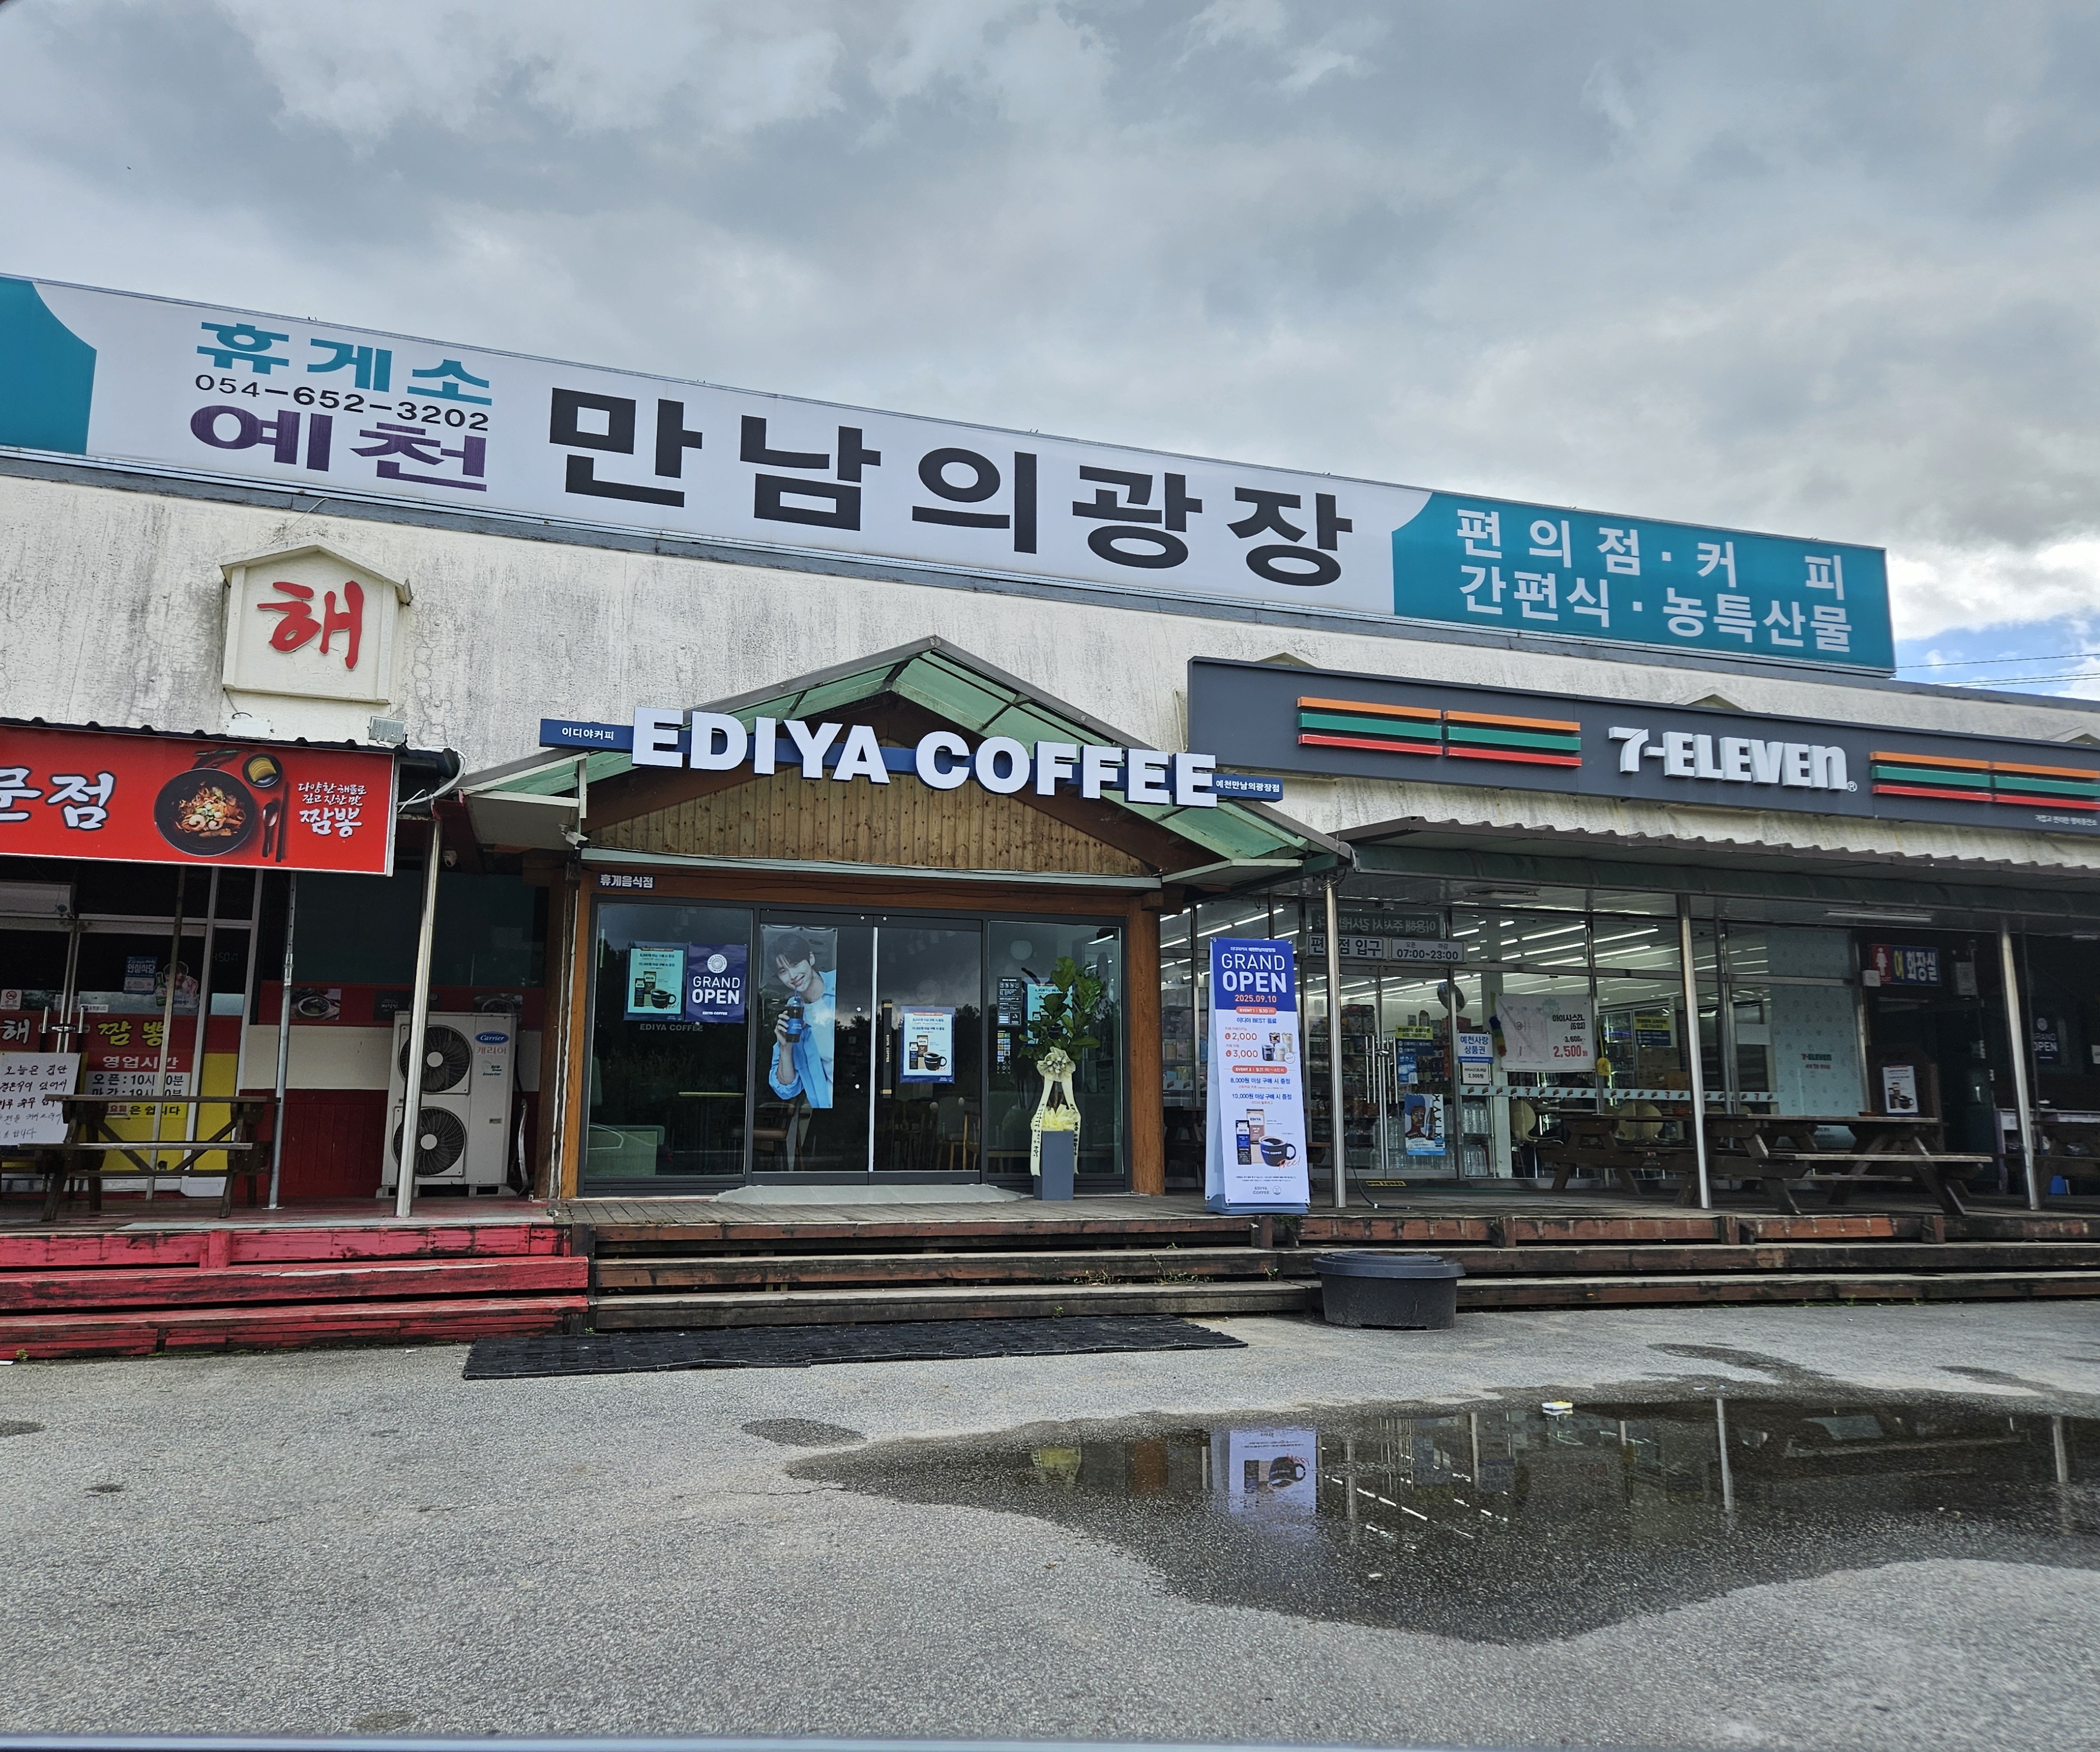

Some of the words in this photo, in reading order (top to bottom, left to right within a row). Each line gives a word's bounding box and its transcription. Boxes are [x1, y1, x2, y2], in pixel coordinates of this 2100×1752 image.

[196, 322, 493, 407] 휴게소
[194, 374, 490, 431] 054-652-3202
[190, 405, 487, 492] 예천
[256, 580, 365, 672] 해
[562, 727, 614, 741] 이디야커피
[632, 706, 890, 785] EDIYA
[915, 731, 1217, 807] COFFEE
[298, 781, 337, 794] 다양한
[337, 784, 367, 795] 해물로
[1216, 780, 1280, 793] 예천만남의광장점
[302, 793, 322, 804] 깊고
[323, 794, 347, 806] 진한
[348, 795, 363, 806] 맛
[299, 807, 362, 837] 짬뽕
[600, 873, 653, 889] 휴게음식점
[1310, 936, 1351, 955] 편점
[1355, 938, 1381, 957] 입구
[1396, 948, 1459, 960] 07:00~23:00
[1221, 953, 1285, 971] GRAND
[1893, 950, 1904, 979] 여
[1906, 950, 1938, 982] 화장실
[692, 976, 741, 989] GRAND
[1223, 971, 1287, 993] OPEN
[692, 988, 740, 1005] OPEN
[1234, 994, 1277, 1003] 2025.09.10
[0, 1018, 31, 1044] 해
[669, 1024, 704, 1032] COFFEE
[1232, 1032, 1257, 1042] 2,000
[1460, 1035, 1489, 1045] 예천사랑
[476, 1047, 507, 1055] 캐리어
[1233, 1050, 1259, 1059] 3,000
[1464, 1045, 1485, 1054] 상품권
[4, 1064, 39, 1075] 오늘은
[103, 1055, 179, 1070] 영업시간
[165, 1075, 184, 1086] 0분
